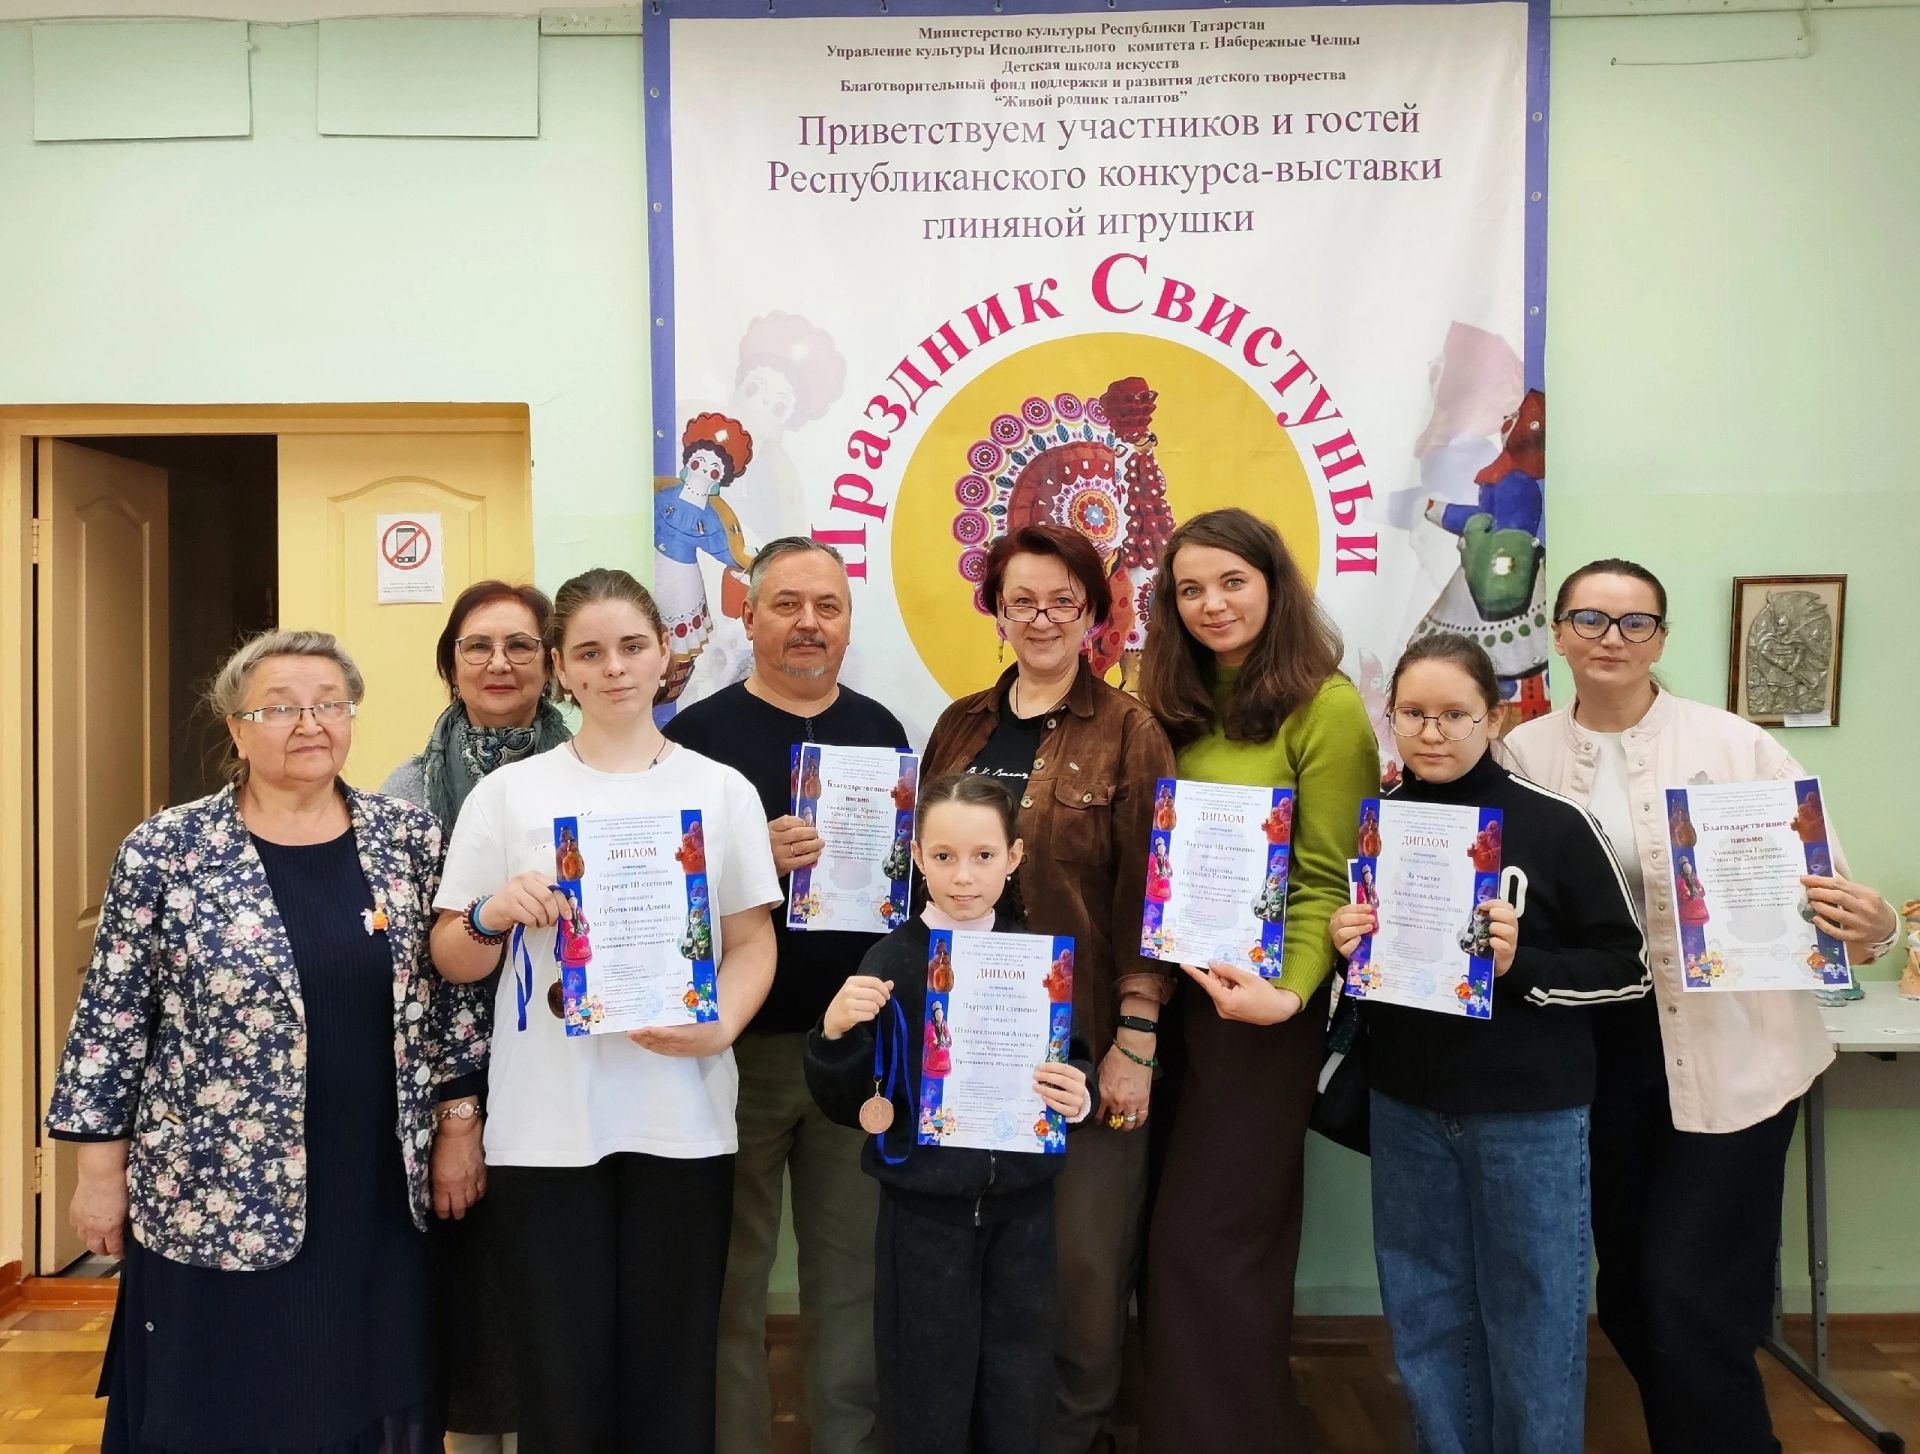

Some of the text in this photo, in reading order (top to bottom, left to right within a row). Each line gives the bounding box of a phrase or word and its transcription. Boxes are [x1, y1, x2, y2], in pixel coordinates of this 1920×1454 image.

[919, 20, 1265, 41] Министерство культуры Республики Татарстан
[826, 34, 1360, 60] Управление культуры Исполнительного комитета г. Набережные Челны
[1001, 58, 1180, 75] Детская школа искусств
[840, 70, 1347, 96] Благотворительный фонд поддержки и развития детского творчества
[1057, 94, 1109, 108] родник
[798, 102, 1421, 154] Приветствуем участников и гостей
[767, 157, 1443, 203] Республиканского конкурса-выставки
[922, 206, 1255, 243] глиняной игрушки
[810, 252, 1379, 585] Праздник Свистуньи
[1198, 811, 1245, 824] ДИПЛОМ
[1702, 821, 1788, 832] Благодарственное
[1401, 835, 1449, 849] ДИПЛОМ
[1730, 836, 1764, 844] письмо
[607, 847, 658, 860] ДИПЛОМ
[976, 967, 1026, 980] ДИПЛОМ
